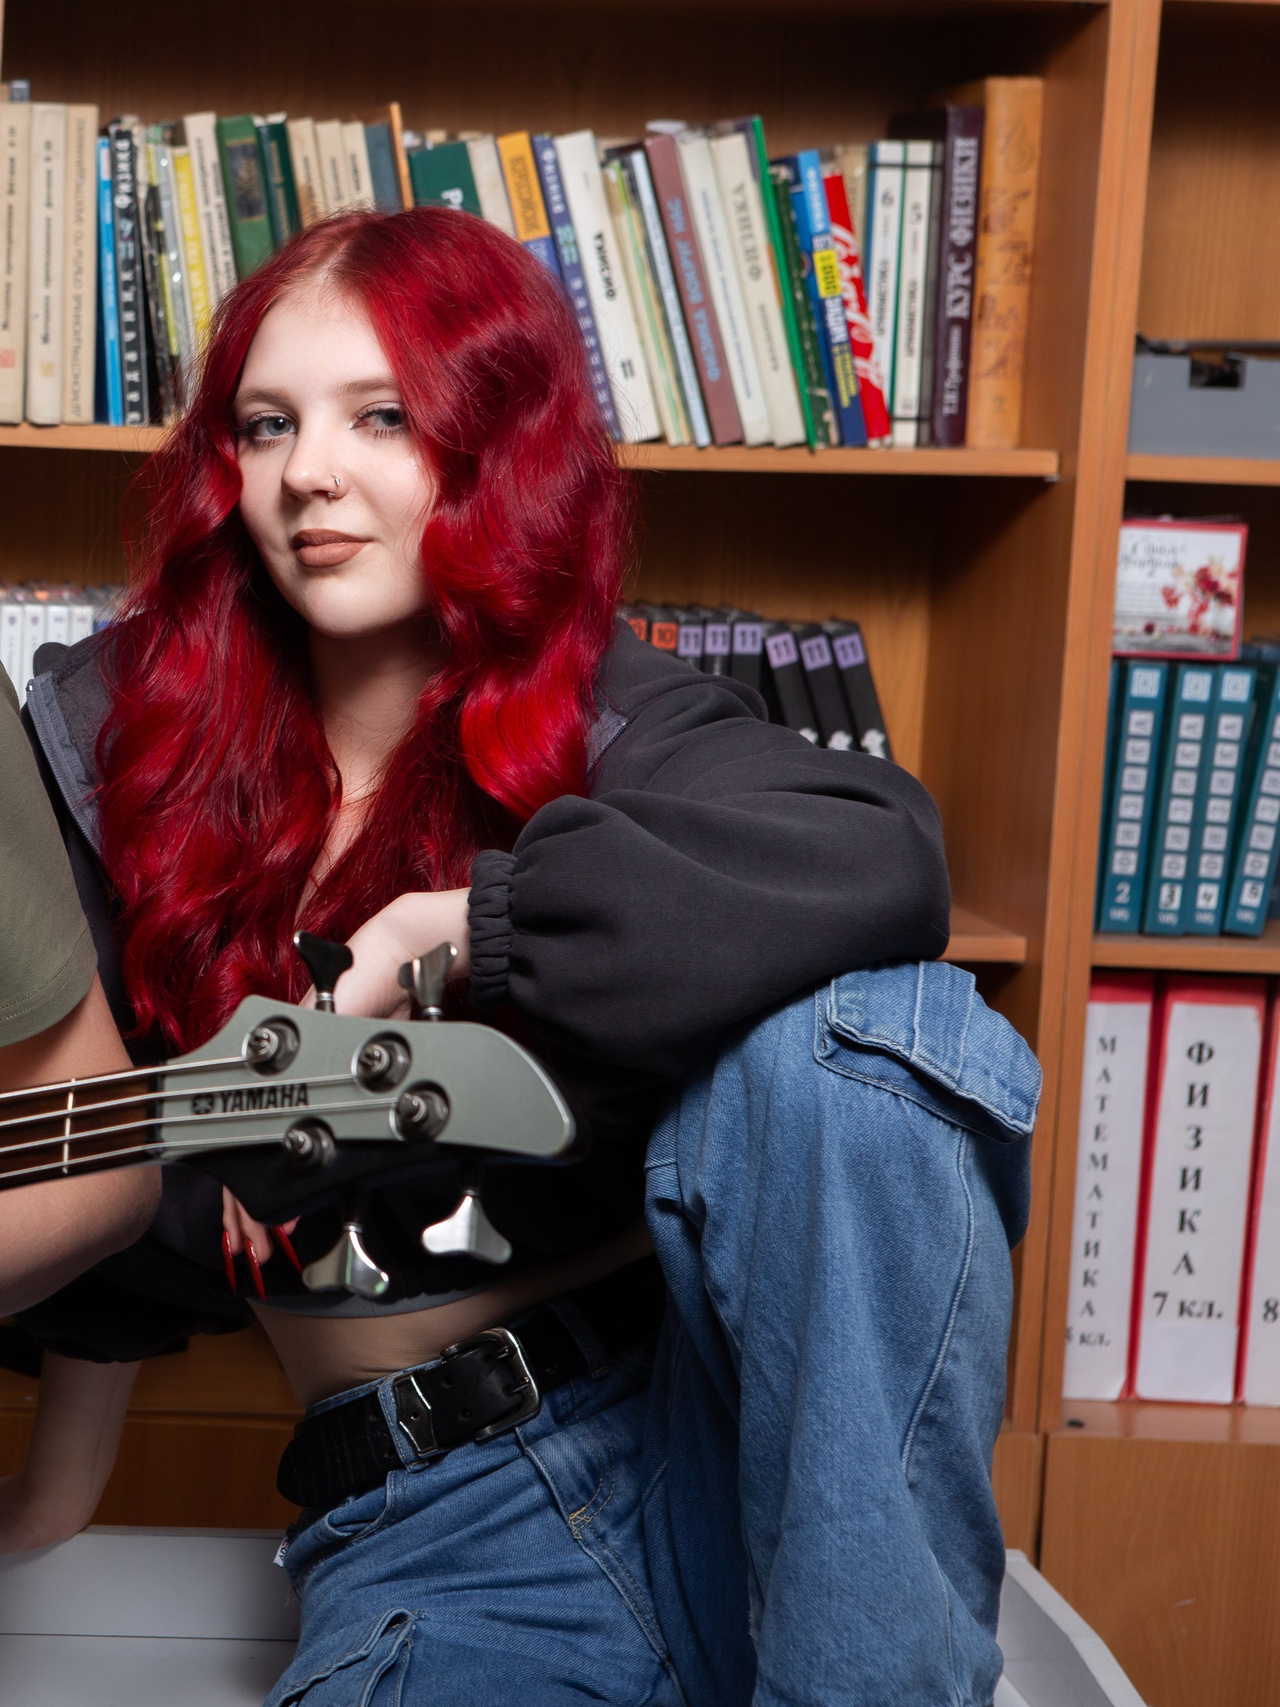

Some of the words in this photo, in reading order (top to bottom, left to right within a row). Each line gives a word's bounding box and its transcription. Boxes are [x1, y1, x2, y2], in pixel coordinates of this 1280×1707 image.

[113, 137, 135, 209] Физика
[948, 135, 979, 247] ФИЗИКИ
[667, 196, 686, 234] НАС
[735, 181, 763, 282] ФИЗИКА
[72, 230, 84, 247] ПО
[71, 249, 84, 290] ОПЫТЫ
[592, 229, 617, 301] ФИЗИКА
[677, 239, 701, 303] ВОКРУГ
[945, 251, 973, 319] КУРС
[70, 293, 84, 419] ДЕМОНСТРАЦИОННЫЕ
[693, 307, 721, 381] ФИЗИКА
[657, 626, 673, 644] 10
[682, 630, 701, 651] 11
[709, 628, 728, 648] 11
[740, 627, 758, 646] 11
[773, 639, 792, 660] 11
[806, 641, 825, 662] 11
[839, 639, 859, 662] 11
[1114, 881, 1131, 904] 2
[220, 1084, 309, 1113] YAMAHA
[1173, 1039, 1215, 1278] ФИЗИКА
[1079, 1035, 1118, 1318] МАТЕМАТИКА
[1152, 1291, 1168, 1317] 7
[1178, 1300, 1224, 1319] кл.
[1262, 1297, 1279, 1323] 8
